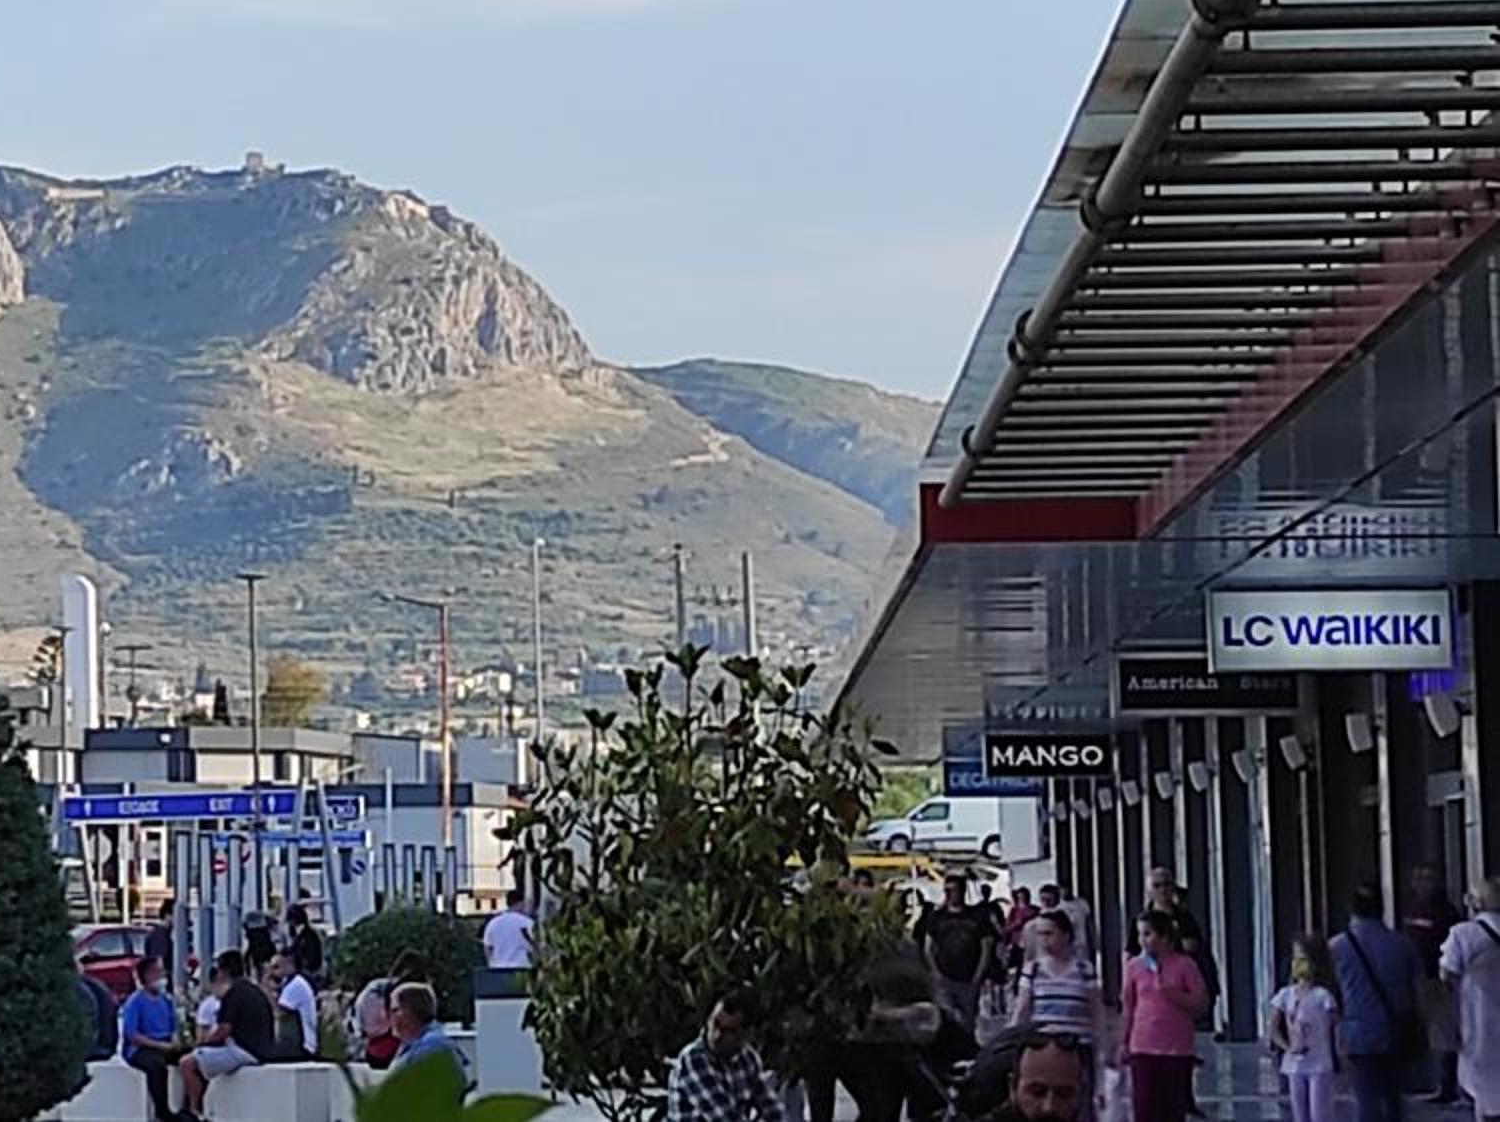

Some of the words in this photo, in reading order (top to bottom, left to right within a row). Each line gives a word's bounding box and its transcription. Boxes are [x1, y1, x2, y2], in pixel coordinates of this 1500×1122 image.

[1221, 615, 1275, 647] LC
[1127, 675, 1219, 691] American
[991, 745, 1104, 767] MANGO
